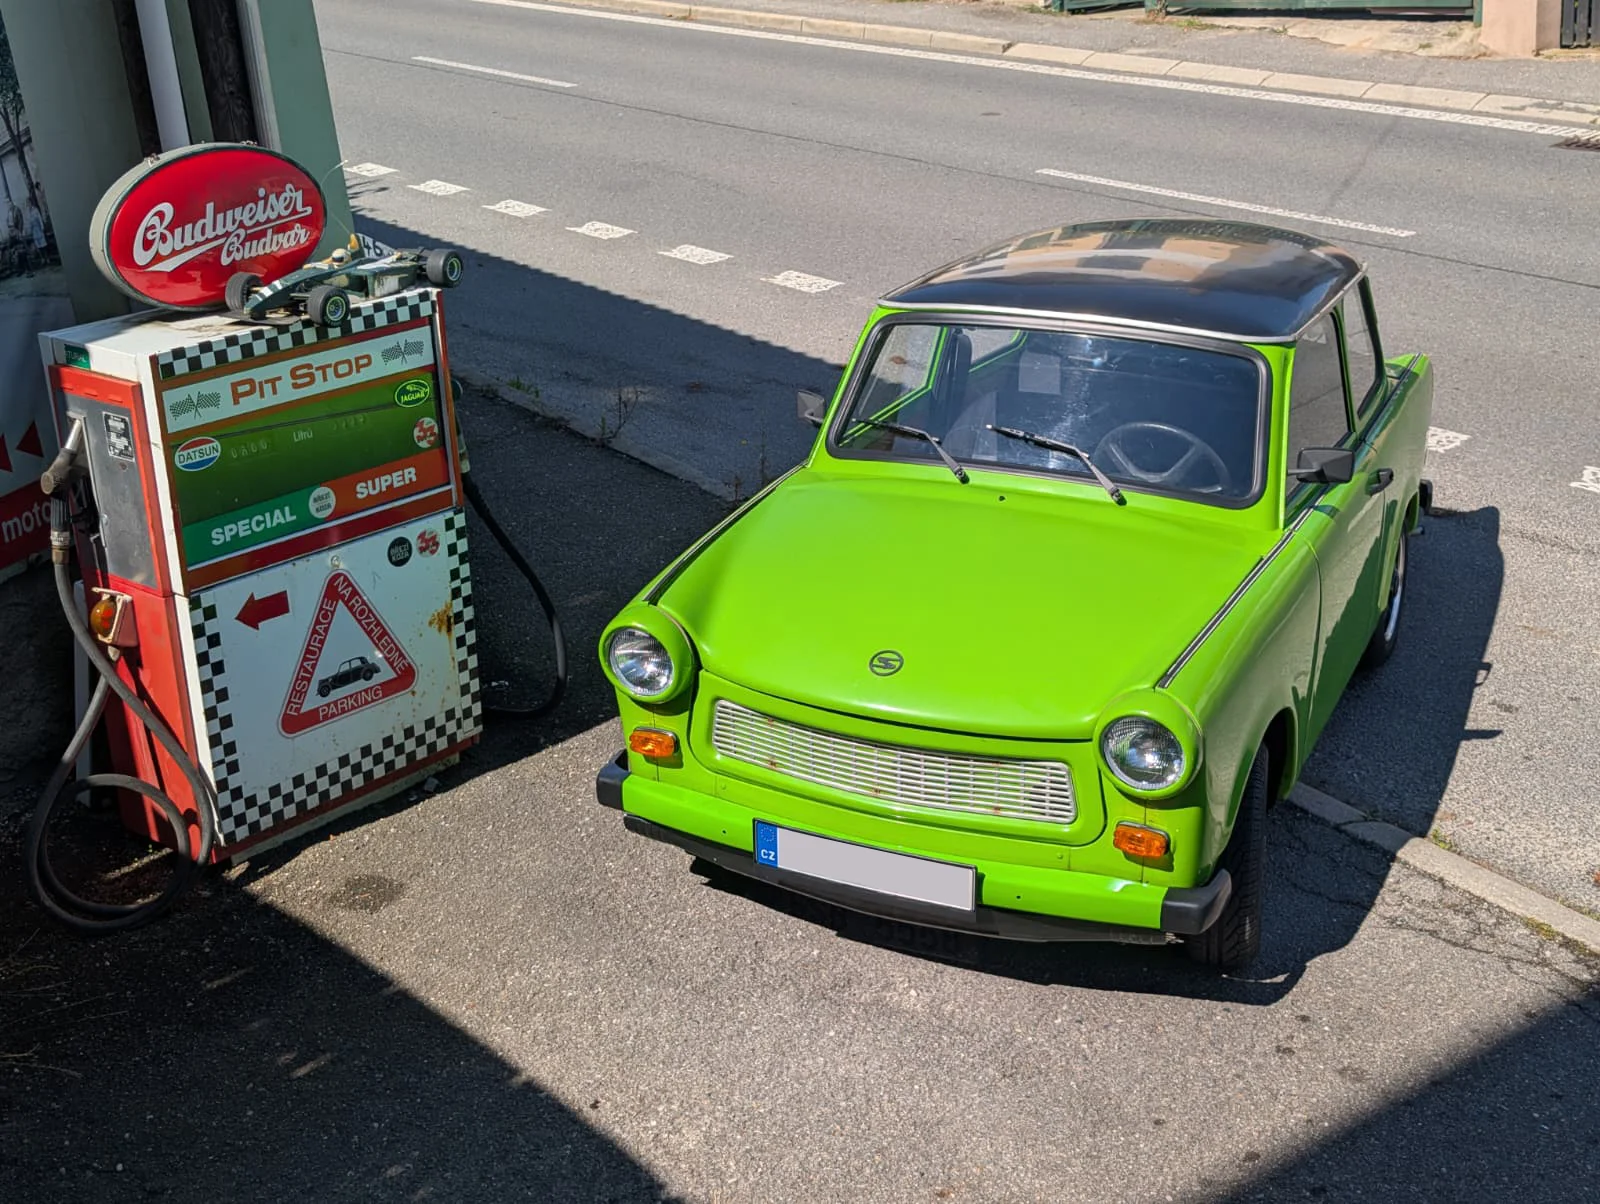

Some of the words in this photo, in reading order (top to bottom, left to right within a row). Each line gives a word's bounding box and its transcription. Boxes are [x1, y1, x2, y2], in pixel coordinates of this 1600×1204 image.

[133, 183, 312, 267] Budweiser
[220, 223, 311, 266] Budvar
[230, 375, 283, 406] PIT
[289, 353, 373, 391] STOP
[401, 391, 426, 405] JAGUAR
[177, 443, 219, 465] DATSUN
[355, 466, 417, 499] SUPER
[210, 505, 297, 546] SPECIAL
[333, 575, 353, 601] NA
[286, 598, 336, 716] RESTAURACE
[318, 685, 383, 721] PARKING
[760, 848, 776, 861] CZ
